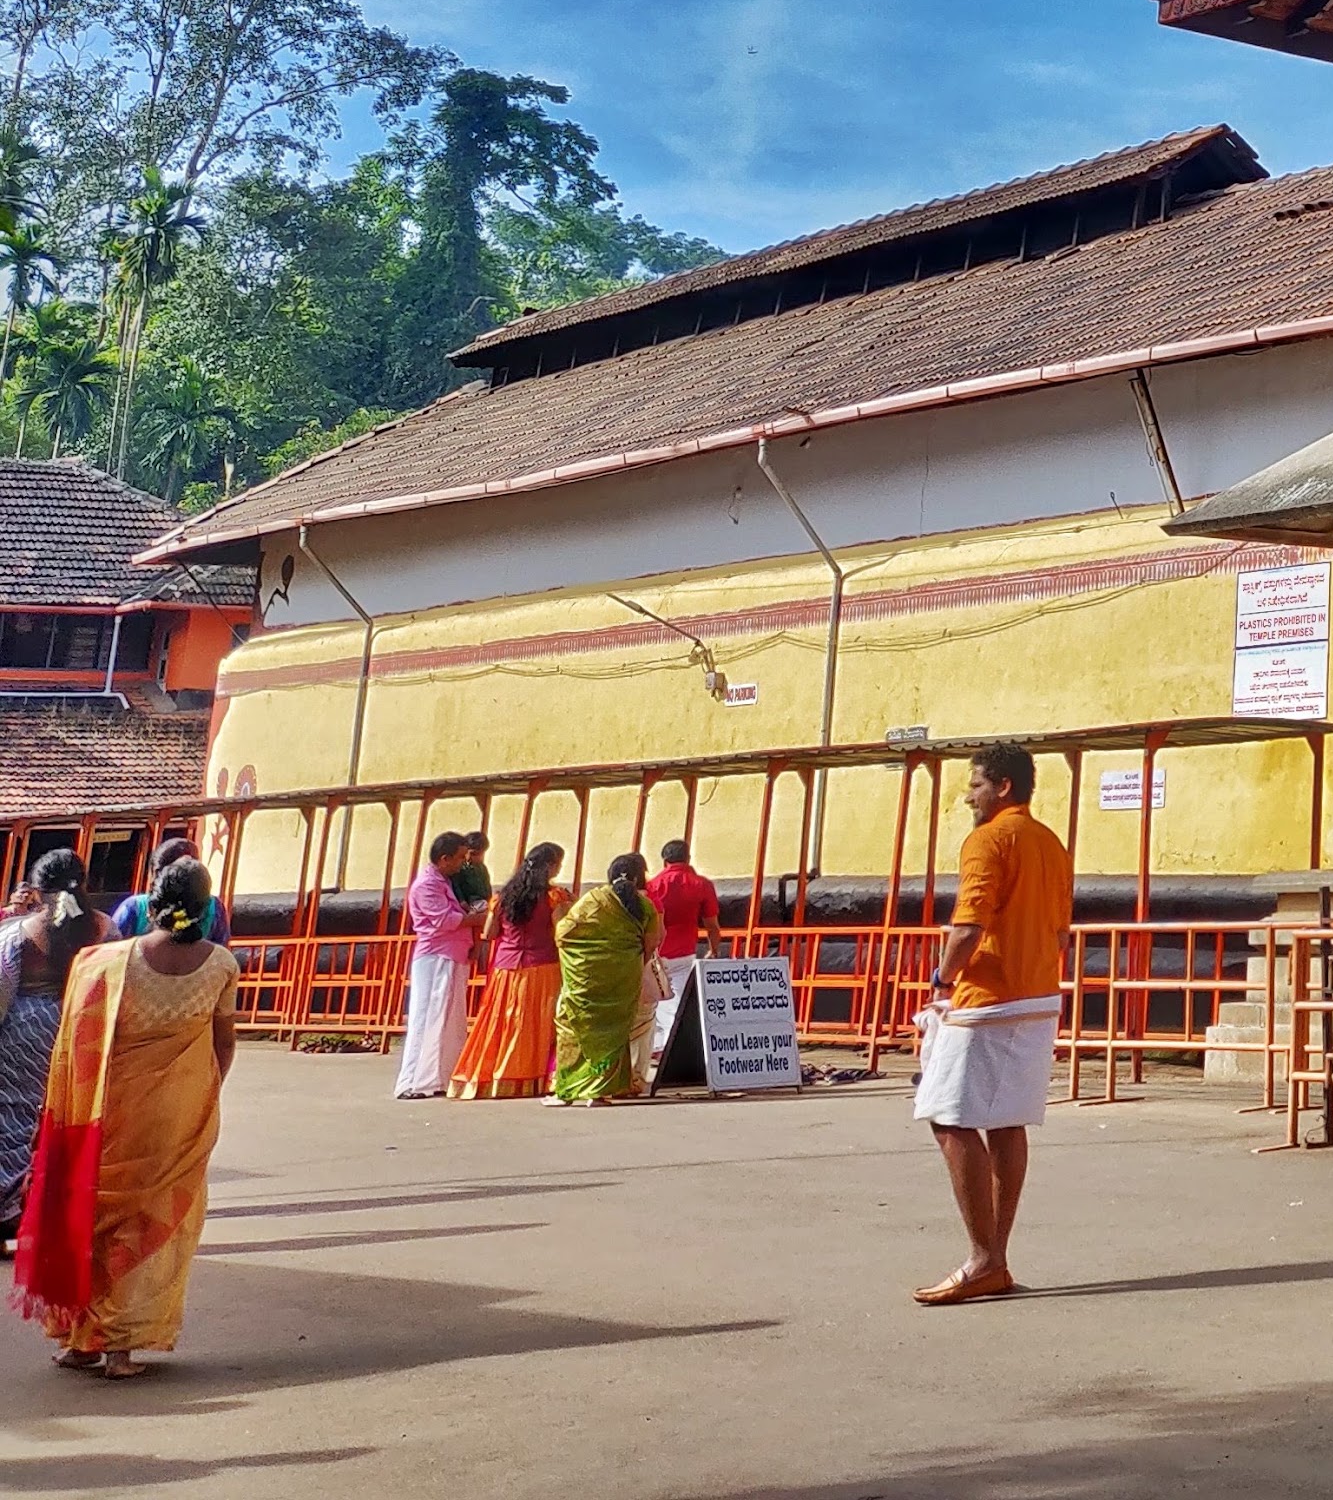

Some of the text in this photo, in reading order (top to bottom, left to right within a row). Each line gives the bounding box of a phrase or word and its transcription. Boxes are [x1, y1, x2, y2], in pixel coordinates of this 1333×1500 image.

[1239, 613, 1326, 630] PLASTICS PROHIBITED IN
[1249, 626, 1314, 642] TEMPLE PREMISES
[706, 964, 787, 992] ಪಾದರಕ್ಷೆಗಳನ್ನು
[706, 997, 727, 1018] ಇಲ್ಲಿ
[710, 1032, 792, 1052] Donot Leave your
[718, 1053, 789, 1075] Footwear Here
